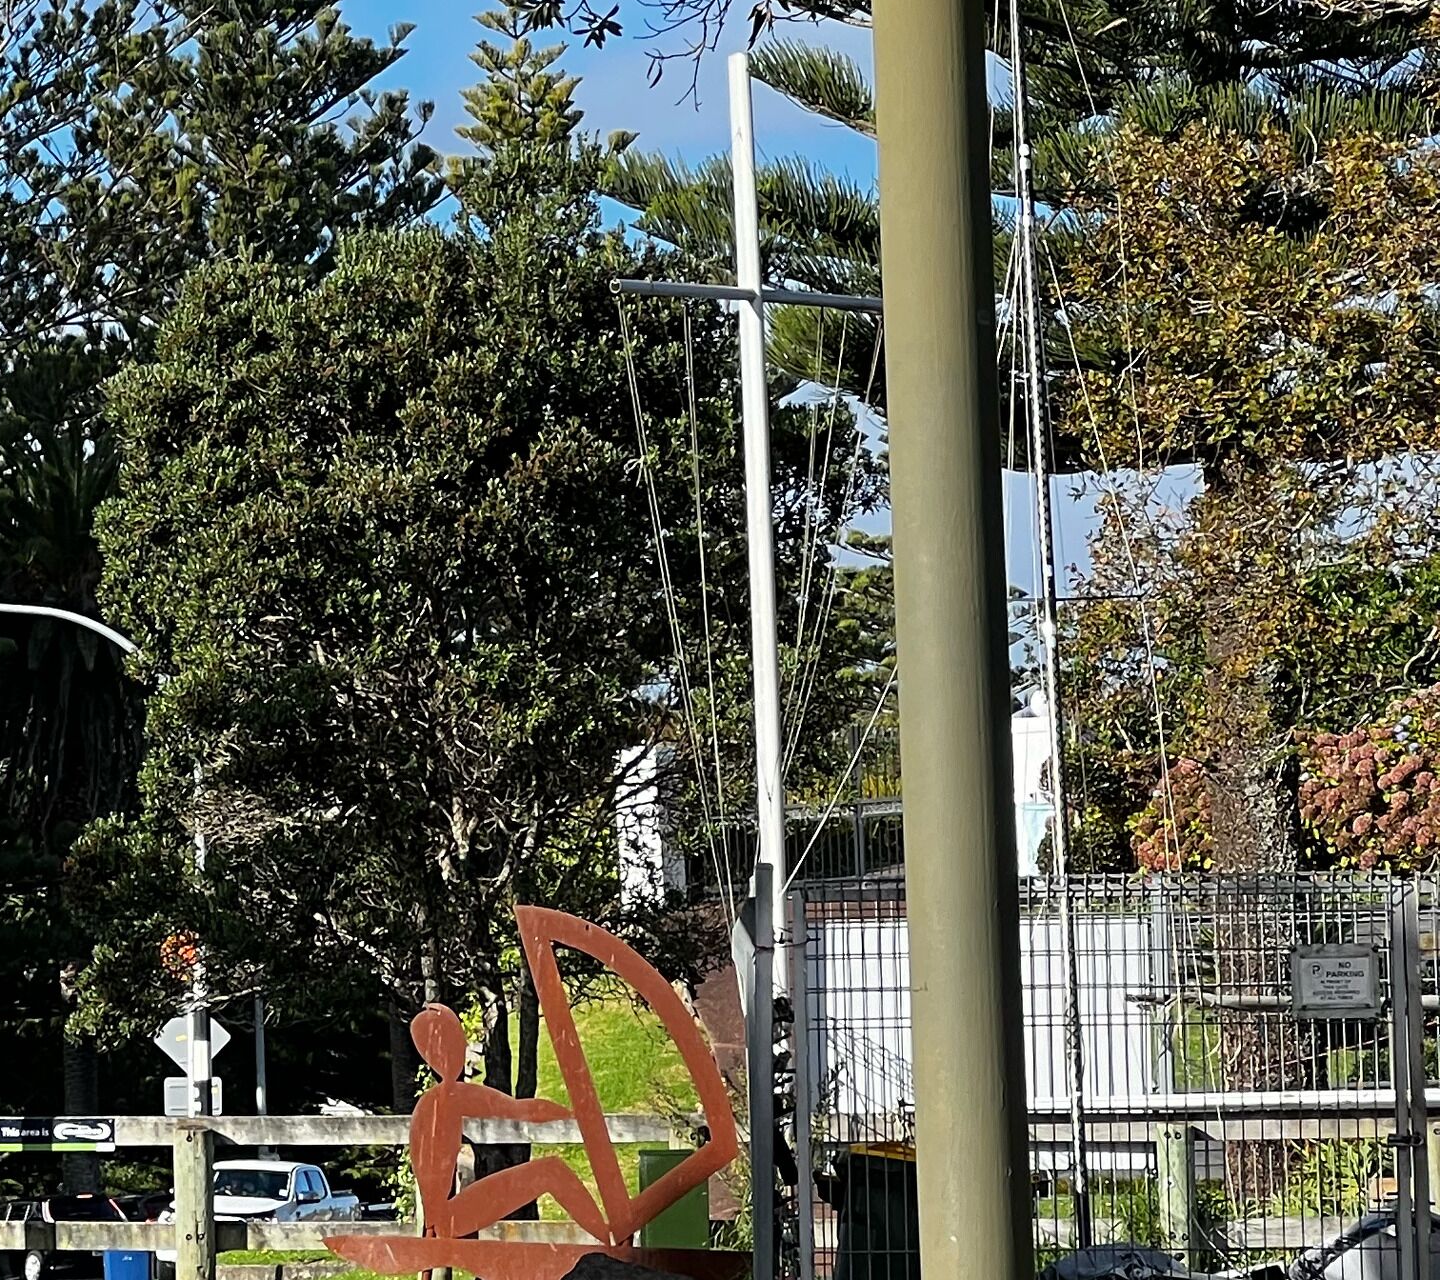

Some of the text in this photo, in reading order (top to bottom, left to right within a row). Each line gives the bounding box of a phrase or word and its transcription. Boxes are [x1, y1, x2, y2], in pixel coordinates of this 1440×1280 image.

[1338, 961, 1352, 969] NO
[1326, 970, 1365, 978] PARKING
[0, 1126, 49, 1137] This area is
